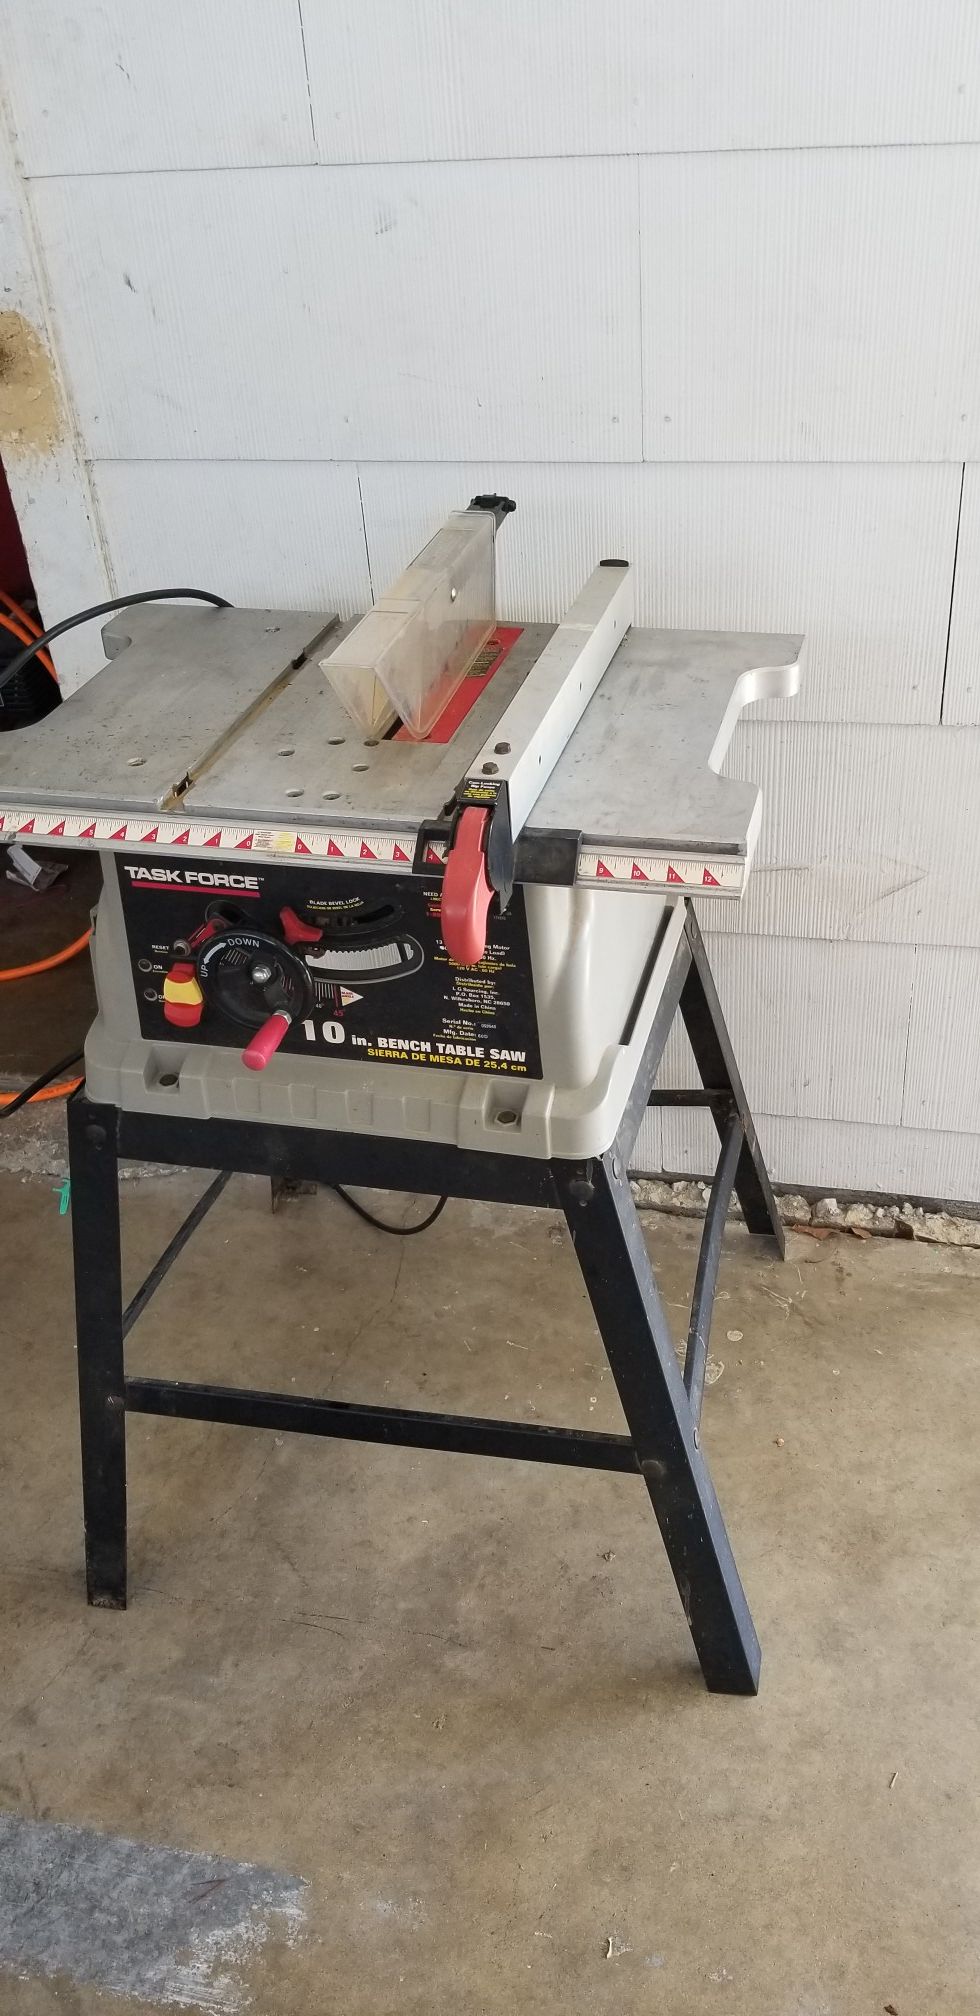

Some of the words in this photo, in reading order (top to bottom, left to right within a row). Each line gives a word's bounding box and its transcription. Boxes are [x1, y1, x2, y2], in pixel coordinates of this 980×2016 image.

[124, 866, 183, 883] TASK
[185, 872, 259, 889] FORCE
[228, 938, 260, 948] DOWN
[200, 964, 209, 977] UP
[455, 976, 486, 984] Distributed
[301, 1020, 345, 1044] 10
[352, 1034, 372, 1047] in.
[377, 1037, 431, 1052] BENCH
[436, 1043, 485, 1058] TABLE
[490, 1048, 526, 1062] SAW
[368, 1048, 408, 1060] SIERRA
[411, 1052, 427, 1061] DE
[430, 1054, 462, 1065] MESA
[466, 1058, 480, 1067] DE
